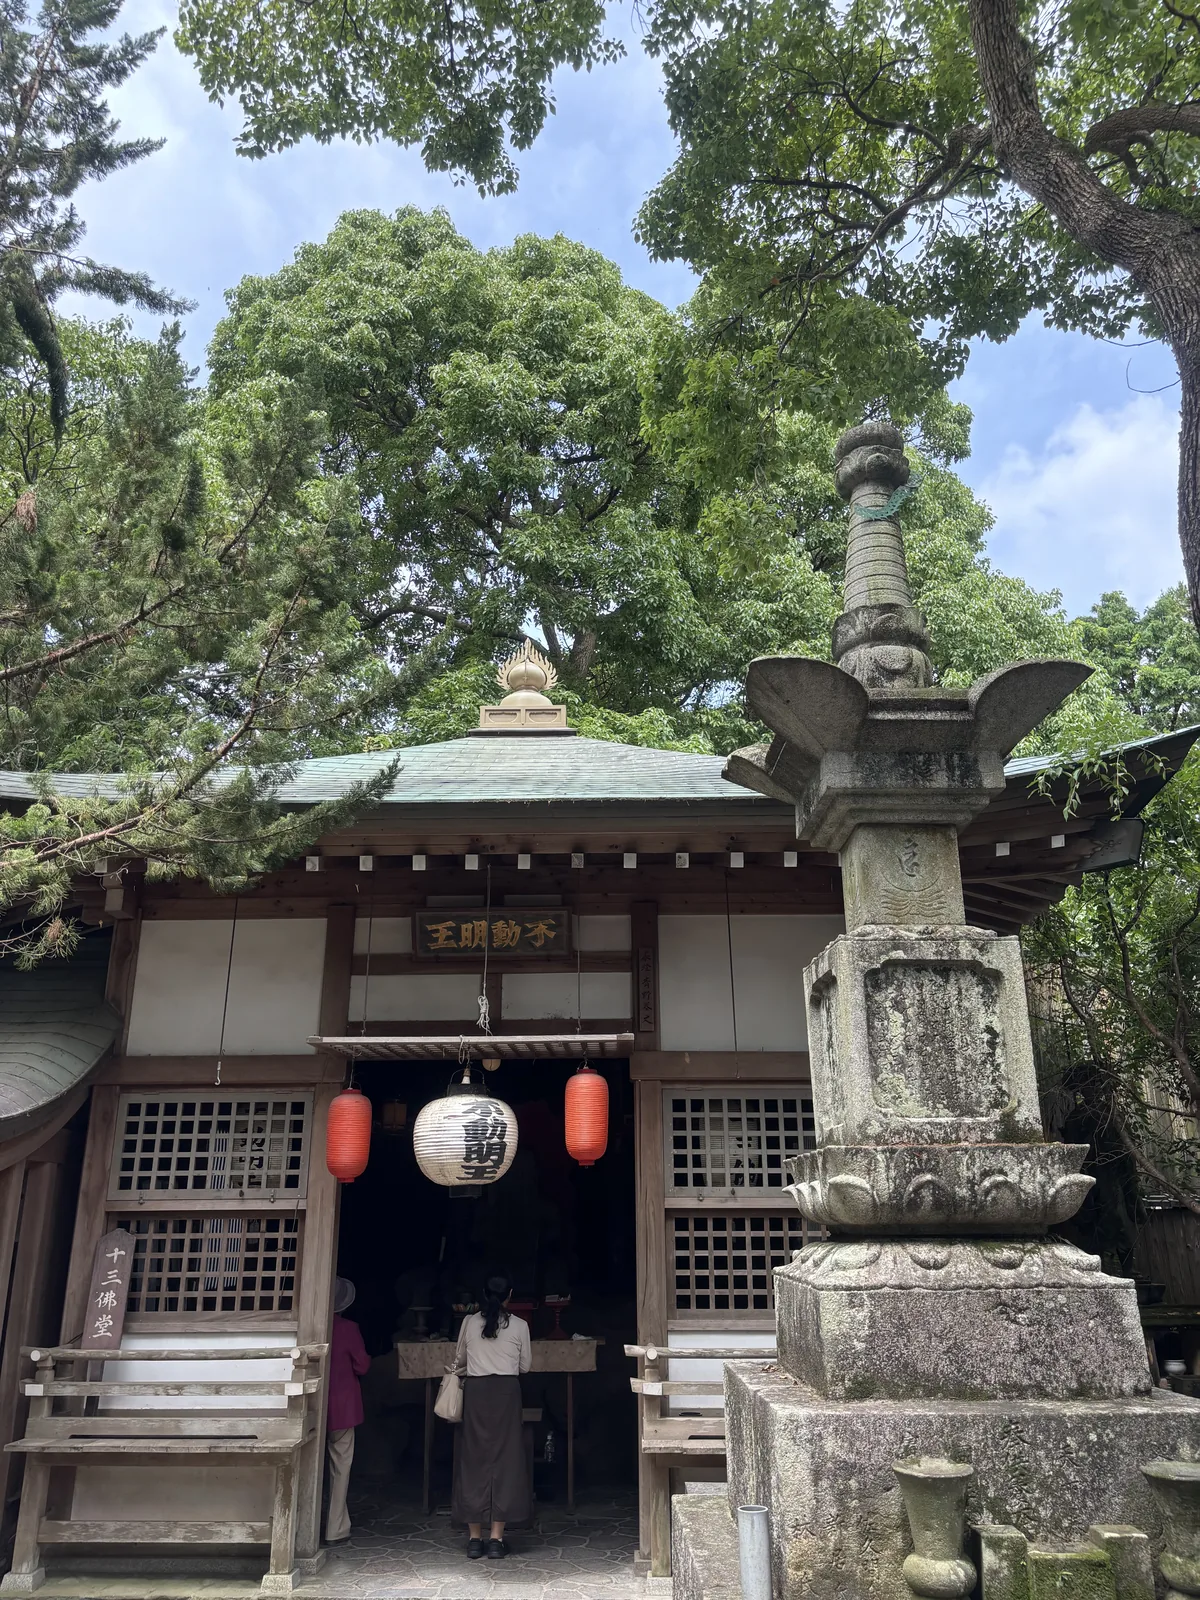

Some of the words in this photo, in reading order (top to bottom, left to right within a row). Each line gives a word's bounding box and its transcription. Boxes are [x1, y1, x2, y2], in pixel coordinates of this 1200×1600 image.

[425, 919, 557, 950] 不動明王
[456, 1099, 508, 1181] 不動明王
[92, 1247, 126, 1338] 十三佛堂
